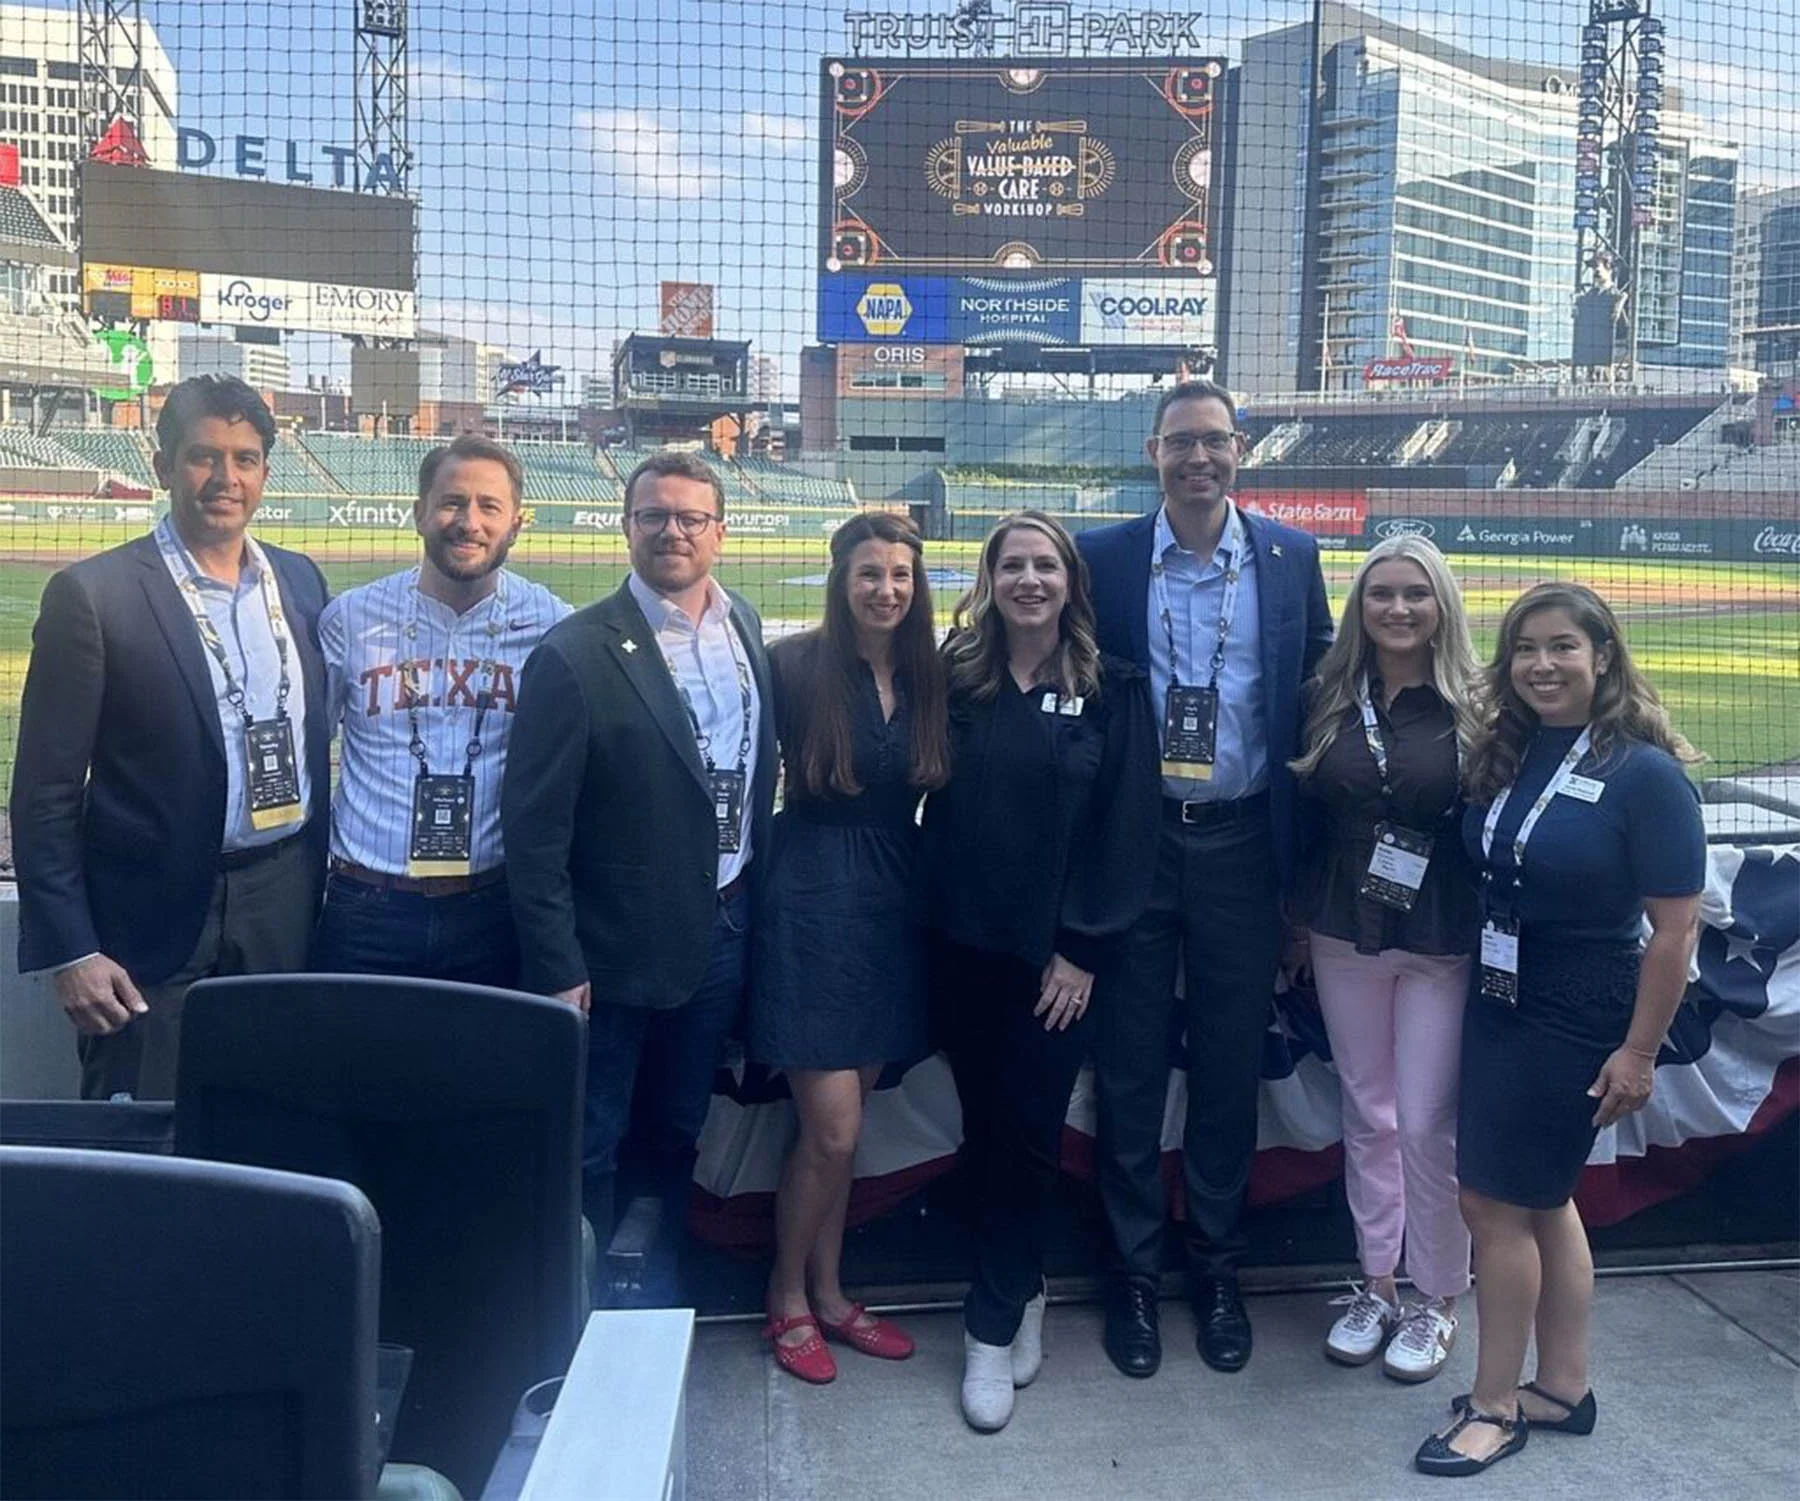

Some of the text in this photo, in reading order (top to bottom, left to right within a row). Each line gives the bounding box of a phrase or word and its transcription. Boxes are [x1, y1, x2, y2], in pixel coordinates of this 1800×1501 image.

[844, 11, 1202, 49] TRUIST PARK
[1009, 120, 1033, 133] THE
[986, 134, 1054, 155] Valuable
[177, 126, 402, 192] DELTA
[998, 178, 1039, 200] CARE
[984, 202, 1053, 216] WORKSHOP
[217, 280, 294, 321] Kroger
[315, 285, 409, 313] EMORY
[865, 297, 905, 320] NAPA
[960, 298, 1070, 313] NORTHSIDE
[1100, 296, 1209, 316] COOLRAY
[979, 313, 1048, 325] HOSPITAL
[874, 346, 926, 362] ORIS
[1369, 362, 1442, 377] RaceTrac
[253, 504, 293, 521] star
[329, 500, 414, 528] xfinity
[1479, 529, 1575, 546] Georgia Power
[360, 658, 517, 717] TEXA
